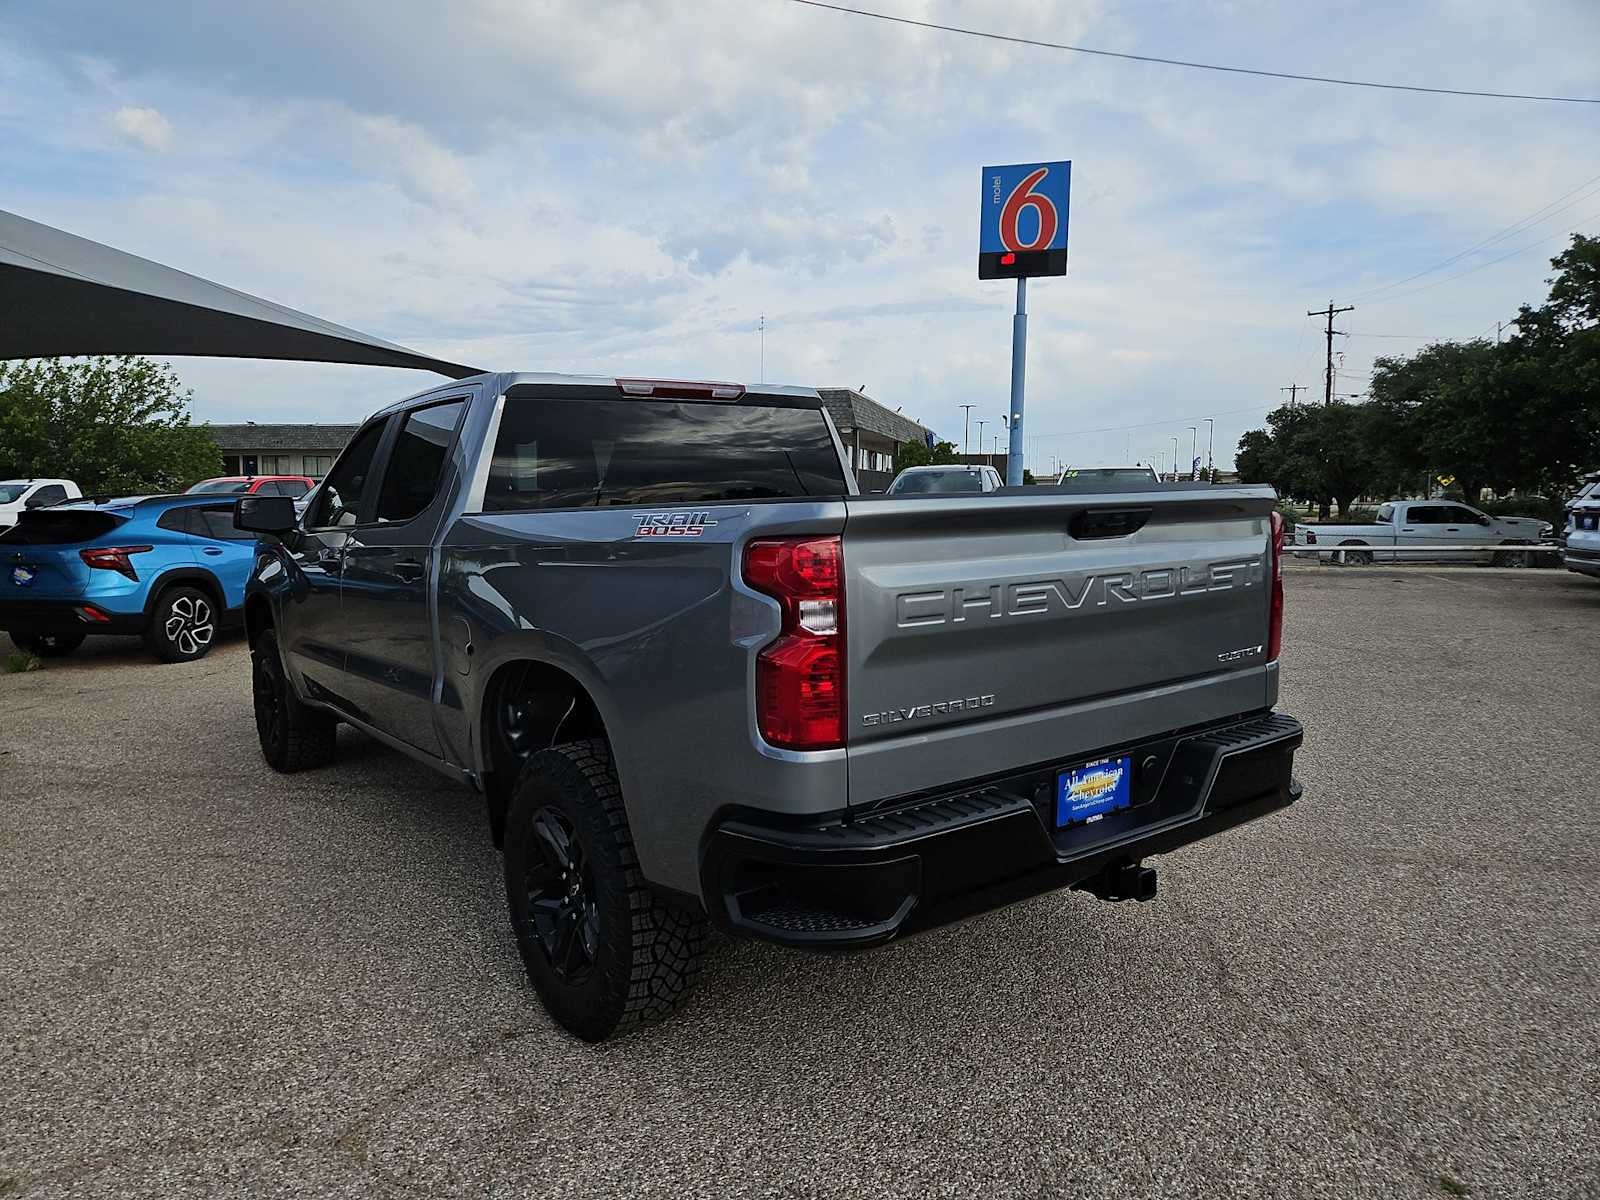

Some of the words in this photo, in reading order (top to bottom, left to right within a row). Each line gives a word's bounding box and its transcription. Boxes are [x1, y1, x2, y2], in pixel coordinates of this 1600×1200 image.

[992, 176, 1001, 204] motel
[999, 167, 1058, 251] 6
[632, 511, 718, 526] TRAIL
[635, 525, 704, 537] BOSS
[896, 553, 1262, 628] CHEVROLET
[862, 694, 995, 726] SILVERADO
